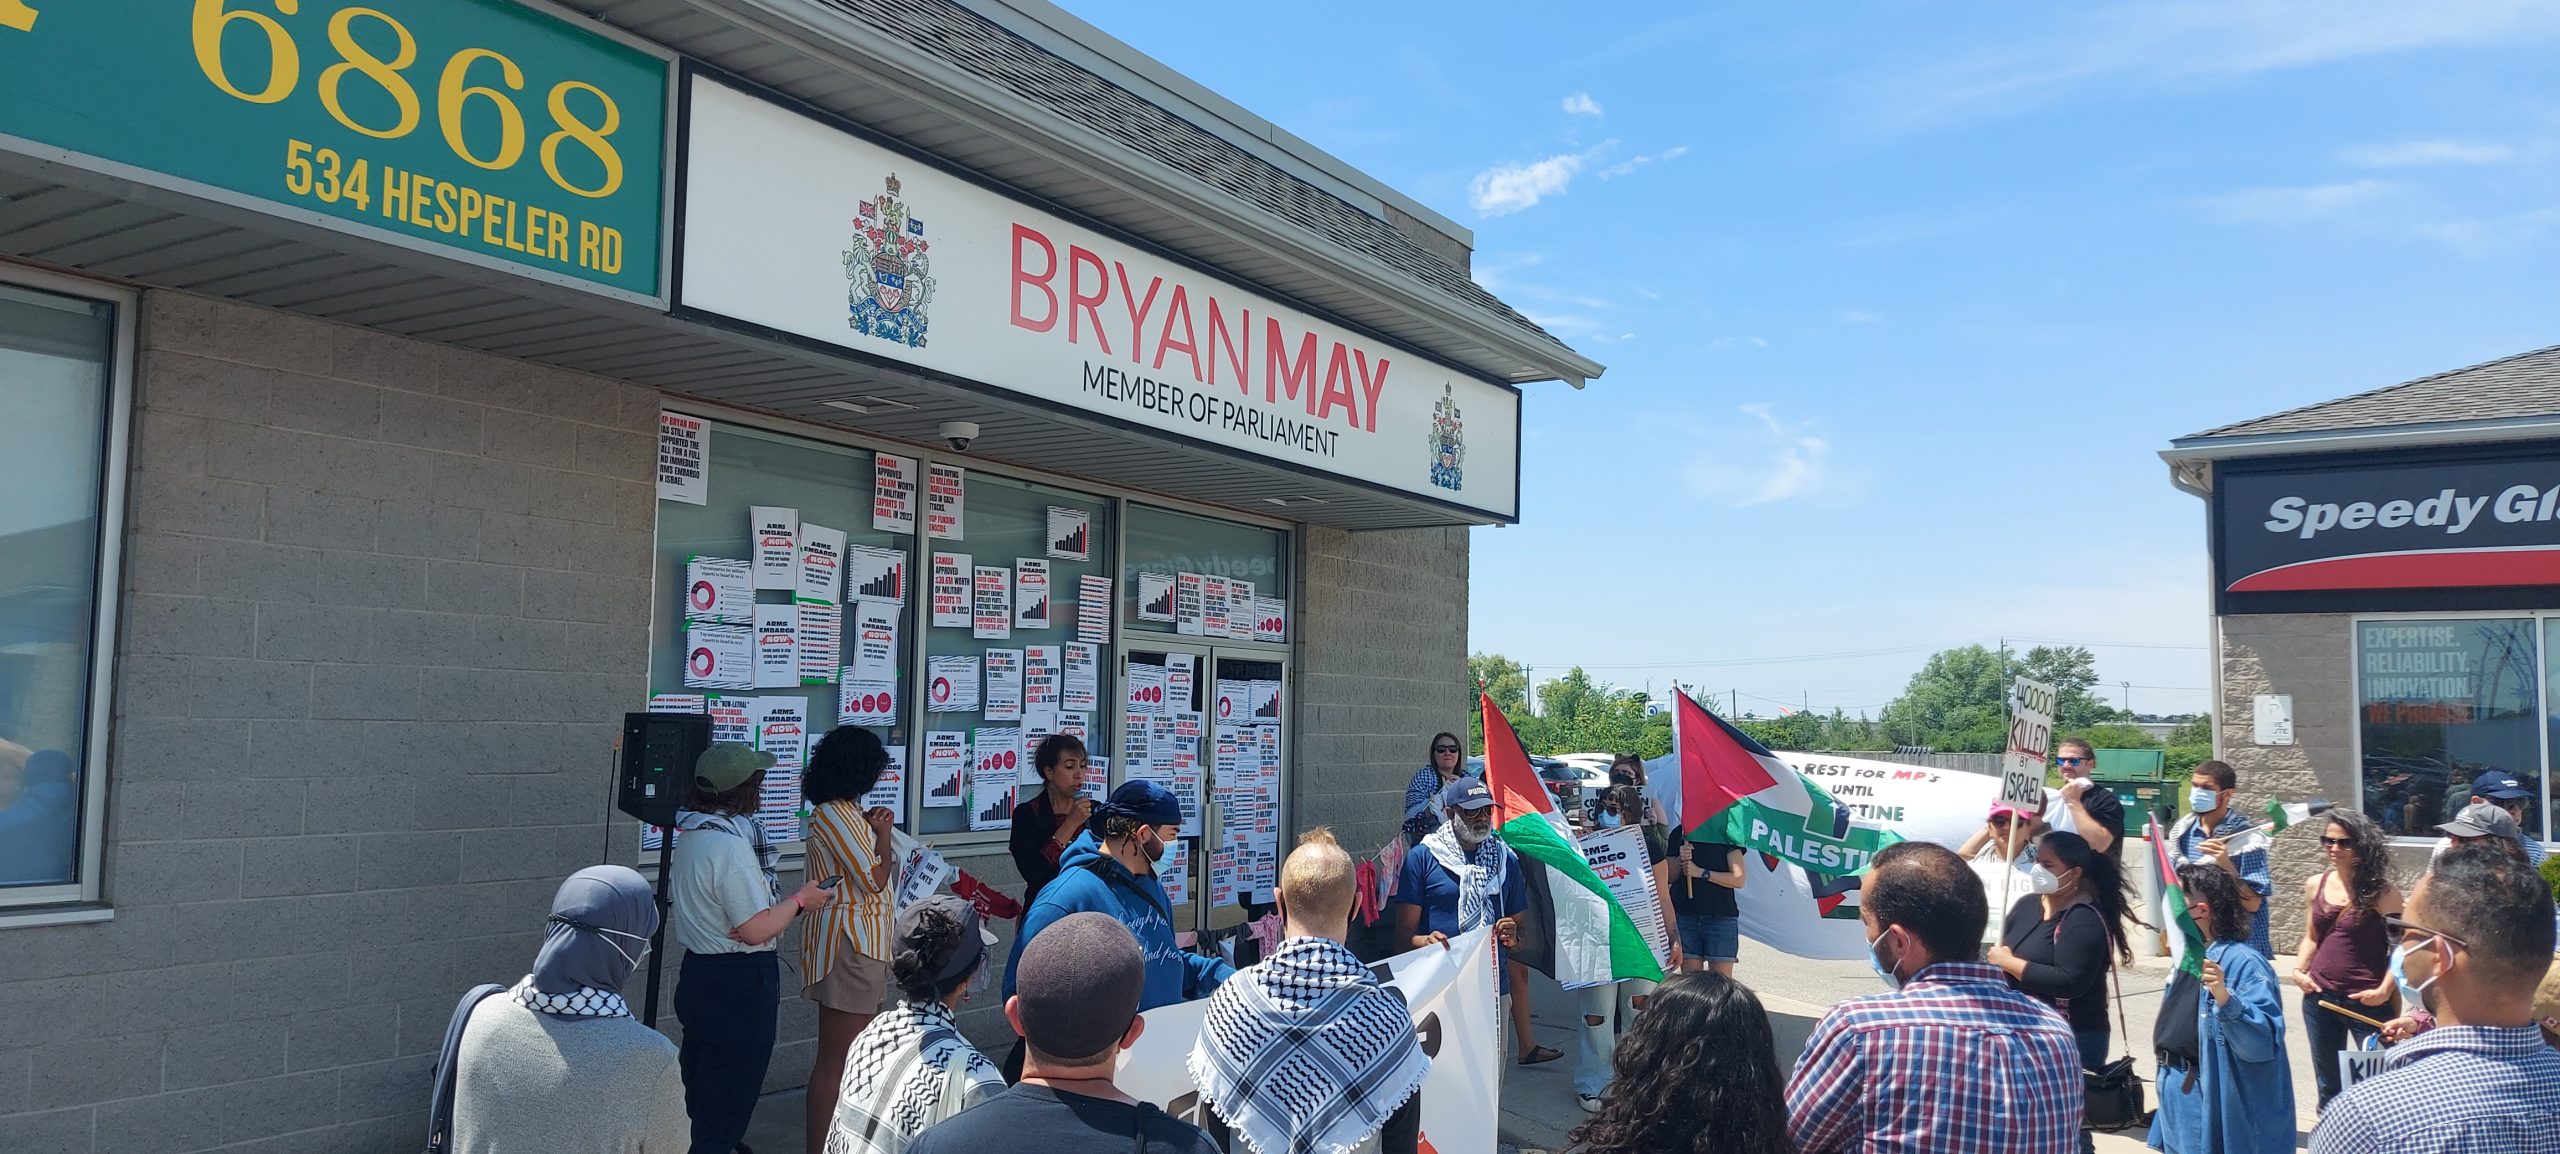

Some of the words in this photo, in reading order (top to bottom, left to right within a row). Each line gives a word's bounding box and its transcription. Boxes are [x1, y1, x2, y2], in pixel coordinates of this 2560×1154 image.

[192, 0, 624, 198] 6868
[286, 139, 370, 211] 534
[382, 166, 569, 263] HESPELER
[580, 224, 623, 275] RD
[1010, 223, 1249, 396] BRYAN
[1266, 317, 1390, 433] MAY
[1083, 360, 1184, 420] MEMBER
[1188, 391, 1218, 425] OF
[1224, 400, 1339, 459] PARLIAMENT
[670, 417, 687, 428] BRYAN
[688, 421, 700, 431] MAY
[671, 427, 684, 437] STILL
[686, 430, 696, 439] NOT
[661, 435, 688, 448] UPPORTED
[690, 441, 699, 449] THE
[661, 445, 671, 454] ALL
[672, 447, 682, 456] FOR
[689, 449, 700, 460] FULL
[660, 454, 668, 463] ND
[670, 456, 700, 469] IMMEDIATE
[877, 457, 896, 468] CANADA
[660, 465, 673, 474] RMS
[675, 467, 700, 479] EMBARGO
[877, 467, 902, 479] APPROVED
[877, 487, 883, 495] OF
[884, 489, 906, 500] MILITARY
[897, 481, 914, 492] WORTH
[930, 503, 945, 512] TTACKS.
[2264, 489, 2489, 539] Speedy
[2494, 482, 2560, 523] Gl
[935, 567, 958, 575] APPROVED
[935, 586, 941, 594] OF
[942, 587, 962, 595] MILITARY
[957, 606, 969, 614] 2023
[2365, 626, 2460, 648] EXPERTISE.
[2366, 652, 2470, 673] RELIABILITY.
[2367, 677, 2474, 698] INNOVATION.
[771, 725, 794, 733] NOW
[2009, 715, 2048, 757] KILLED
[2020, 756, 2028, 768] BY
[1804, 763, 1850, 776] REST
[1855, 770, 1886, 778] FOR
[1832, 785, 1874, 796] UNTIL
[2002, 771, 2039, 804] ISRAEL
[1582, 844, 1610, 856] RMS
[1751, 818, 1873, 870] PALESTI
[1588, 852, 1626, 865] ARGO
